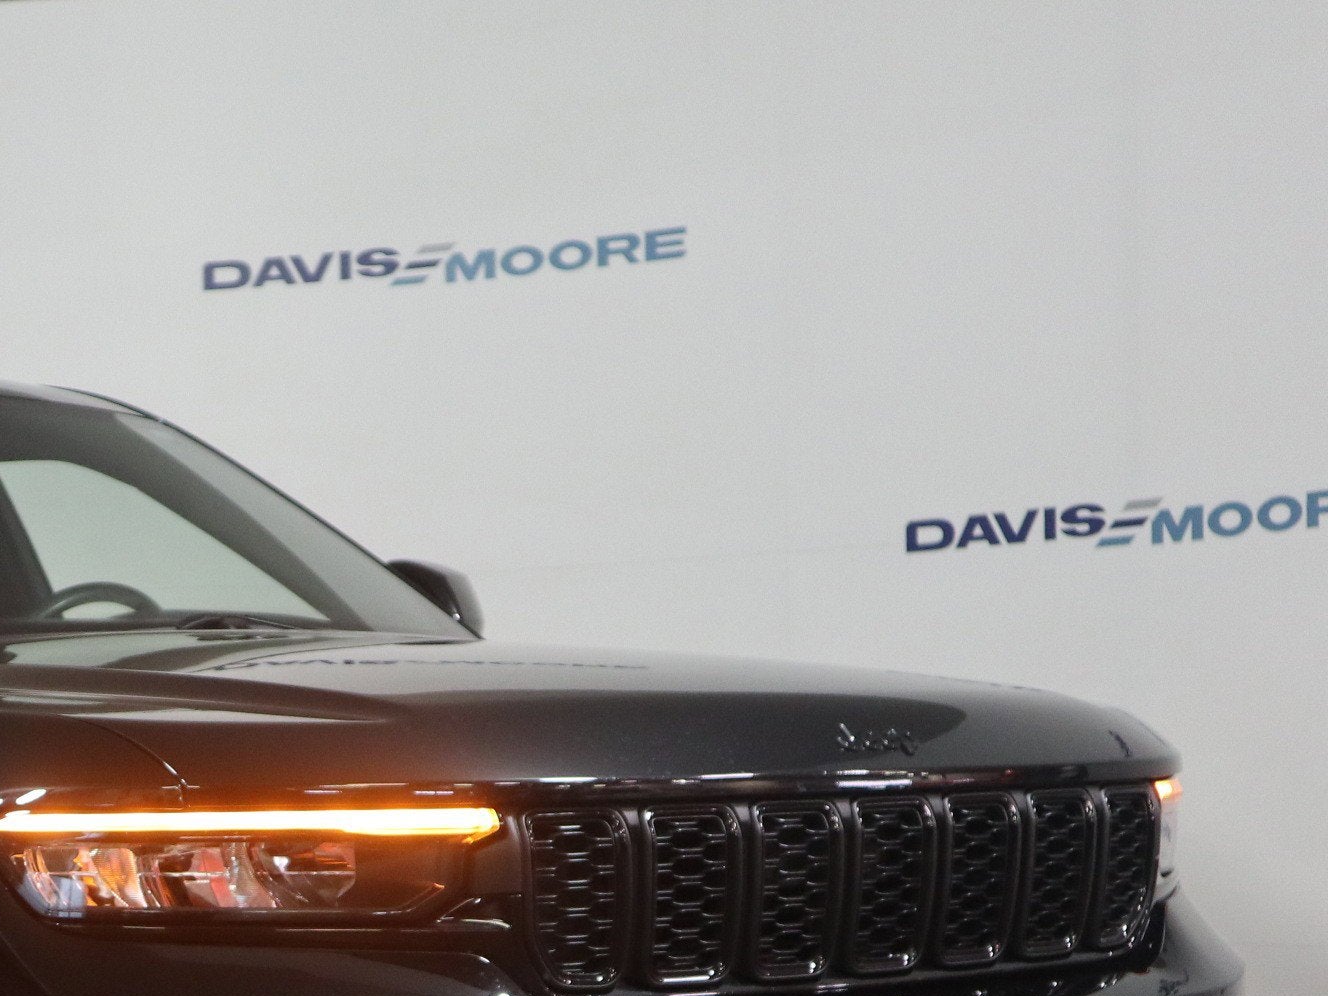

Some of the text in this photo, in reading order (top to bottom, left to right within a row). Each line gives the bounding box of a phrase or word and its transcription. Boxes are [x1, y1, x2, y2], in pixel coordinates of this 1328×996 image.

[202, 226, 688, 290] DAVIS MOORE
[906, 503, 1106, 553] DAVIS
